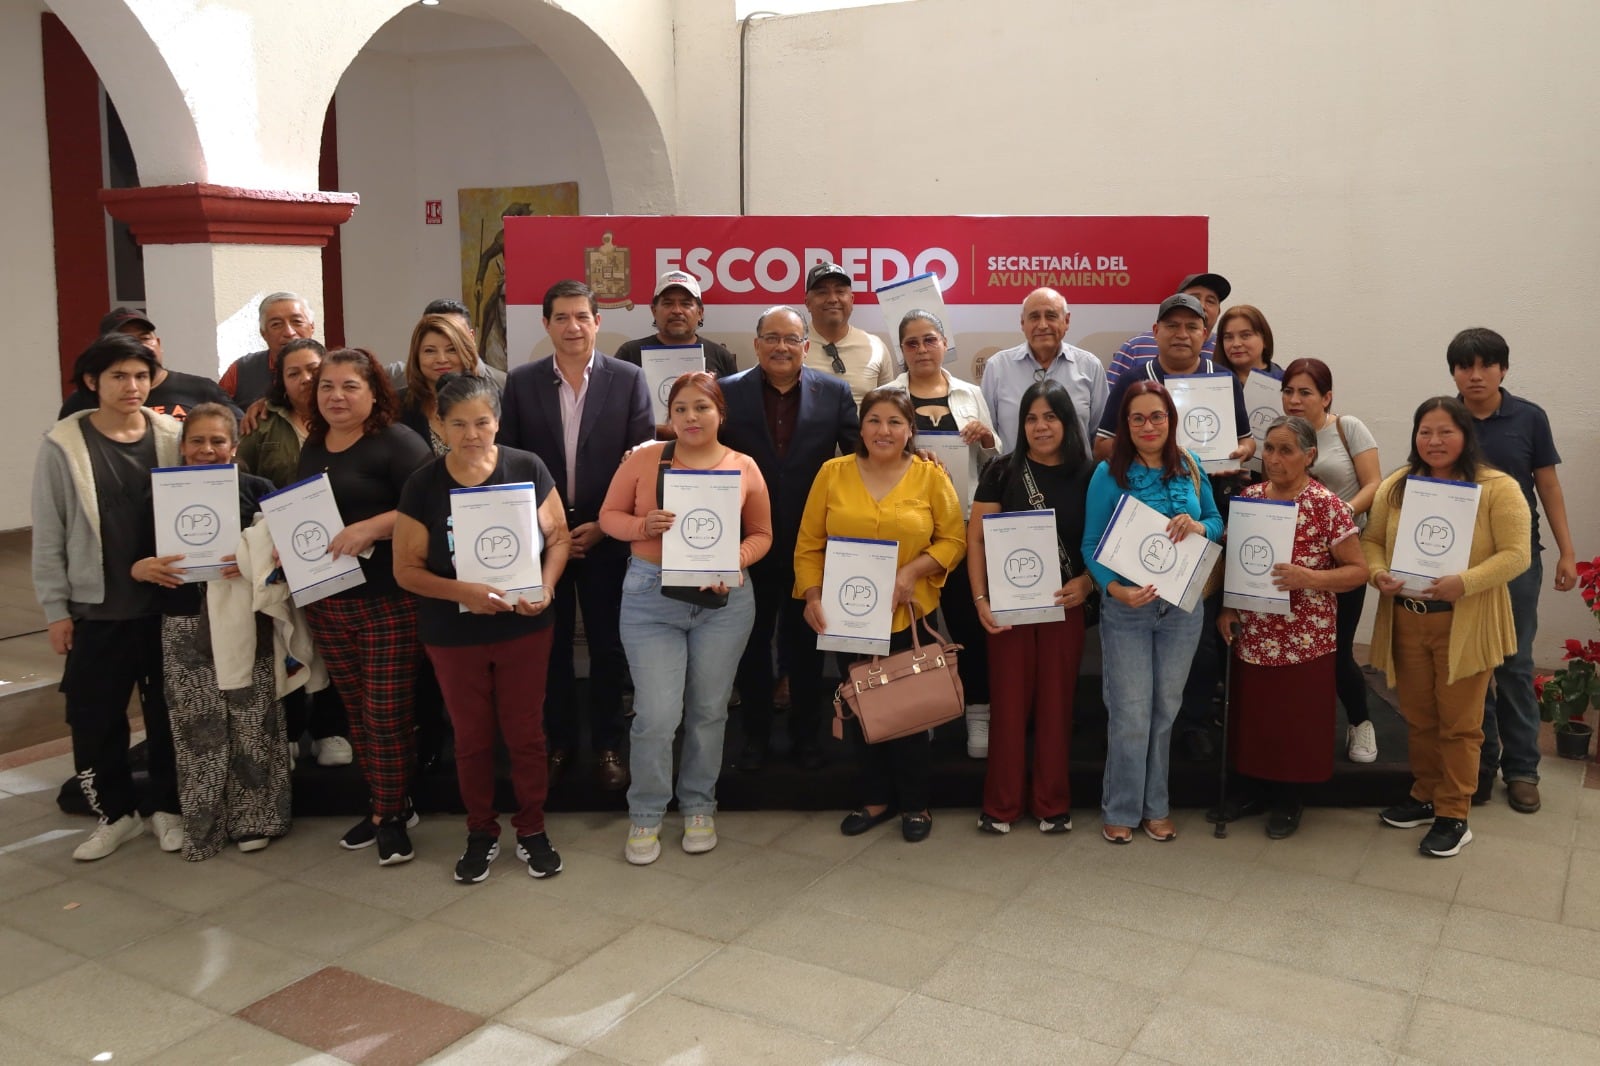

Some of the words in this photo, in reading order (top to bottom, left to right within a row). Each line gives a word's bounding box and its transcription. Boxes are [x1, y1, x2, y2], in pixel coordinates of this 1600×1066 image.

[988, 252, 1092, 271] SECRETARÍA
[1097, 256, 1128, 270] DEL
[988, 272, 1130, 287] AYUNTAMIENTO
